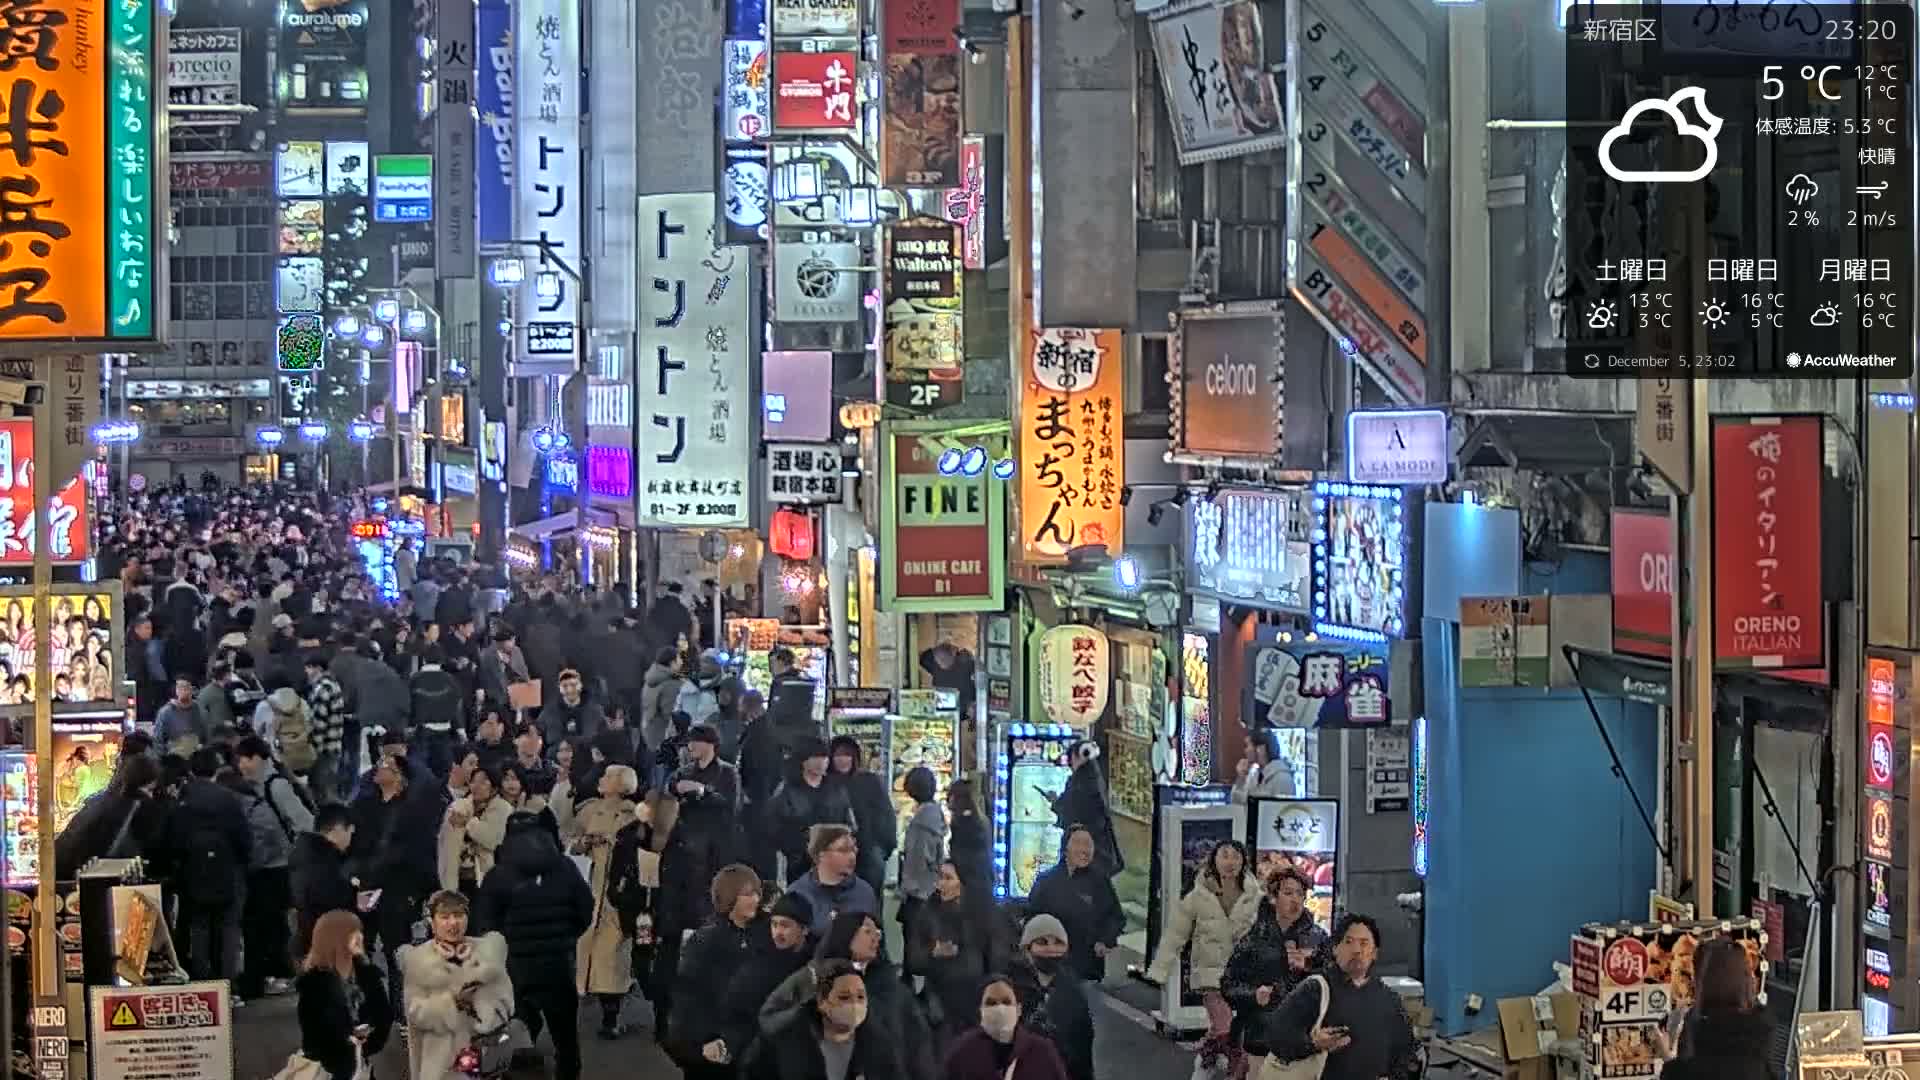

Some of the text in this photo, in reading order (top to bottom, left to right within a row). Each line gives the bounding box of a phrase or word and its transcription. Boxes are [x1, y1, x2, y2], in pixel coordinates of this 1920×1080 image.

[1307, 23, 1327, 42] 5
[1308, 75, 1326, 92] 4
[654, 210, 687, 464] トントン
[1206, 353, 1256, 396] celona
[910, 385, 940, 405] 2F
[772, 451, 837, 472] 酒場心
[1034, 396, 1079, 546] まっちゃん
[904, 485, 980, 514] FINE
[1749, 431, 1781, 604] 俺のイタリアン
[904, 560, 982, 575] ONLINE CAFE
[1734, 616, 1801, 633] ORENO
[1733, 634, 1801, 650] ITALIAN
[1606, 992, 1640, 1015] 4F
